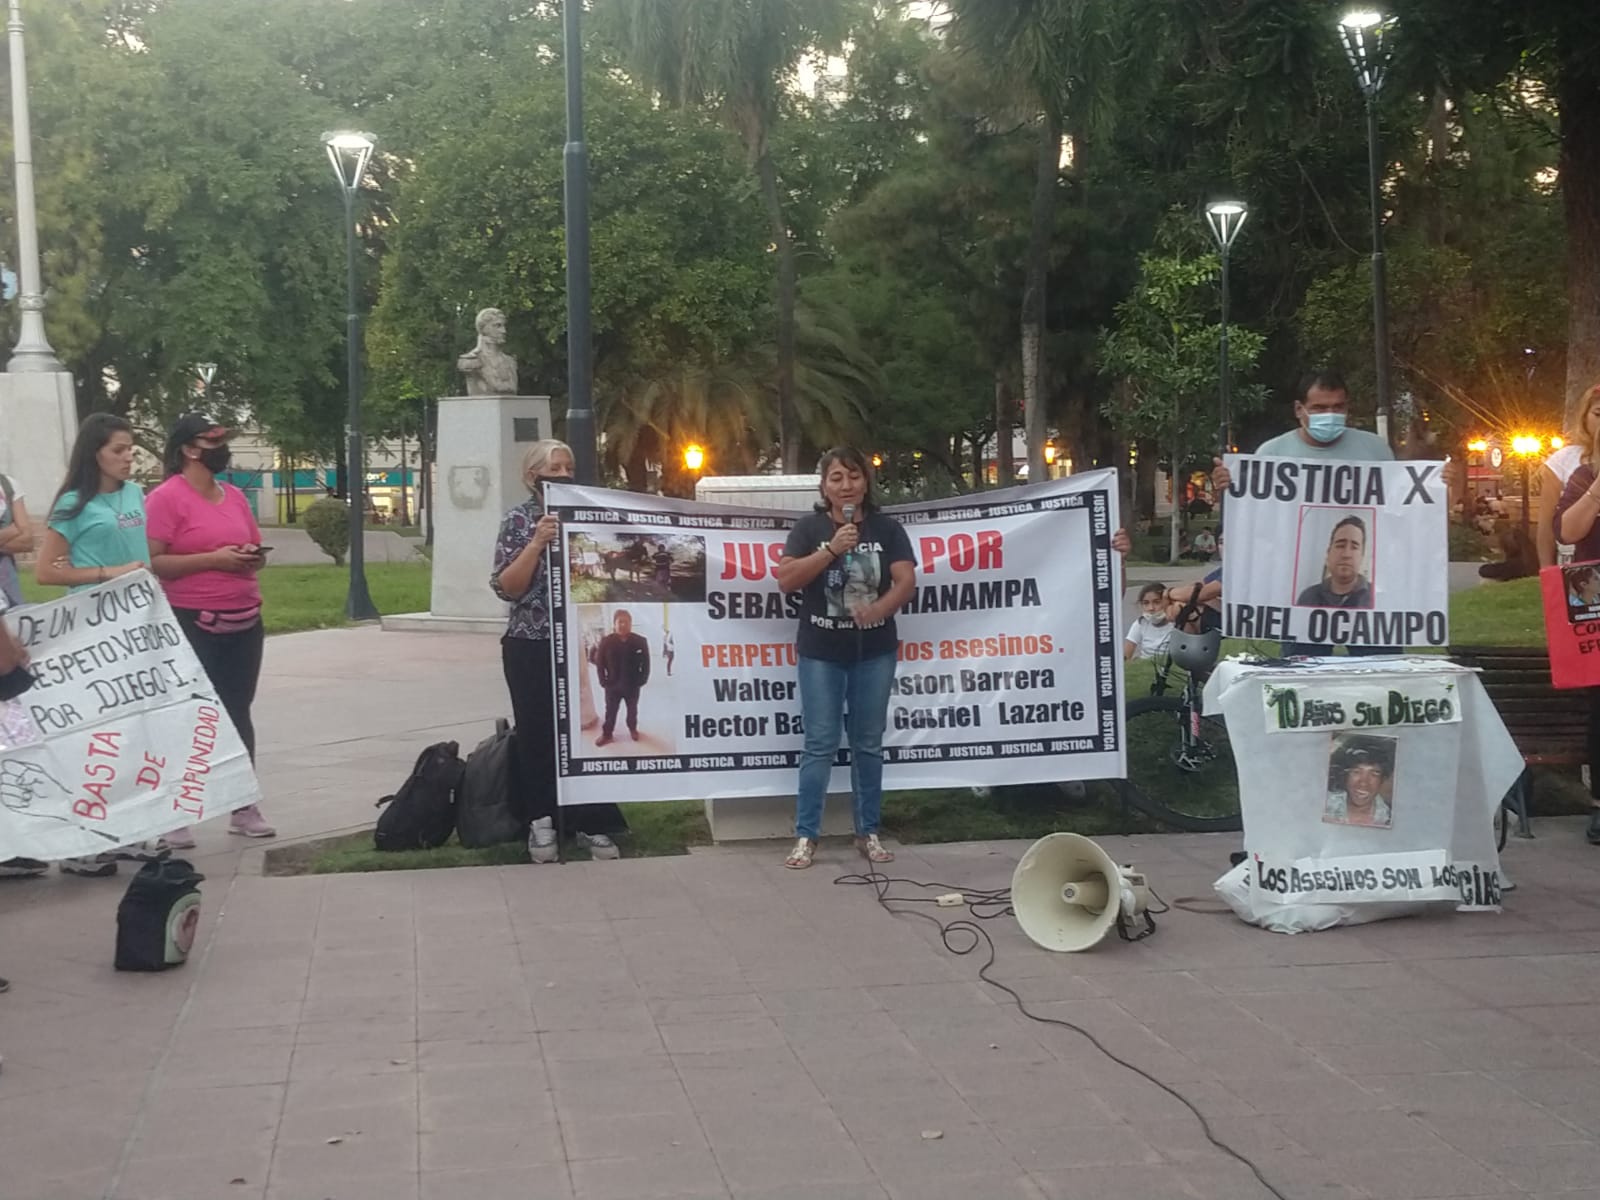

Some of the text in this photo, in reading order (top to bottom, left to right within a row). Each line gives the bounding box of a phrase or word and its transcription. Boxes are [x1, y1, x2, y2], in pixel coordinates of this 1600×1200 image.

[1229, 460, 1437, 505] JUSTICIA X
[574, 510, 620, 523] JUSTICA
[627, 512, 672, 525] JUSTICA
[678, 515, 723, 528] JUSTICA
[730, 517, 776, 529] JUSTICA
[897, 496, 1084, 524] STICA JUSTICA JUSTICA JUSTICA
[1093, 494, 1106, 537] JUSTICA
[720, 541, 787, 582] JUS
[920, 530, 1003, 574] POR
[1096, 548, 1108, 590] JUSTICA
[19, 580, 156, 647] DE UN JOVEN
[707, 578, 1042, 620] SEBAS HANAMPA
[1098, 602, 1111, 644] JUSTICA
[1308, 609, 1445, 645] OCAMPO
[701, 643, 798, 668] PERPETU
[1100, 655, 1113, 697] JUSTICA
[30, 703, 83, 734] POR
[86, 667, 168, 714] DIEGO
[713, 678, 796, 702] Walter
[960, 668, 1055, 692] Barrera
[685, 714, 769, 738] Hector
[775, 712, 805, 735] Ba
[999, 700, 1085, 726] Lazarte
[1268, 687, 1299, 729] 10
[898, 747, 942, 760] JUSTICA
[949, 745, 994, 758] JUSTICA
[1000, 743, 1044, 755] JUSTICA
[1050, 739, 1094, 751] JUSTICA
[1102, 709, 1115, 751] JUSTICA
[136, 751, 166, 790] DE
[582, 760, 628, 773] JUSTICA
[635, 758, 682, 771] JUSTICA
[688, 757, 735, 769] JUSTICA
[742, 754, 787, 767] JUSTICA
[1257, 861, 1288, 893] LOS
[1382, 867, 1423, 890] SON
